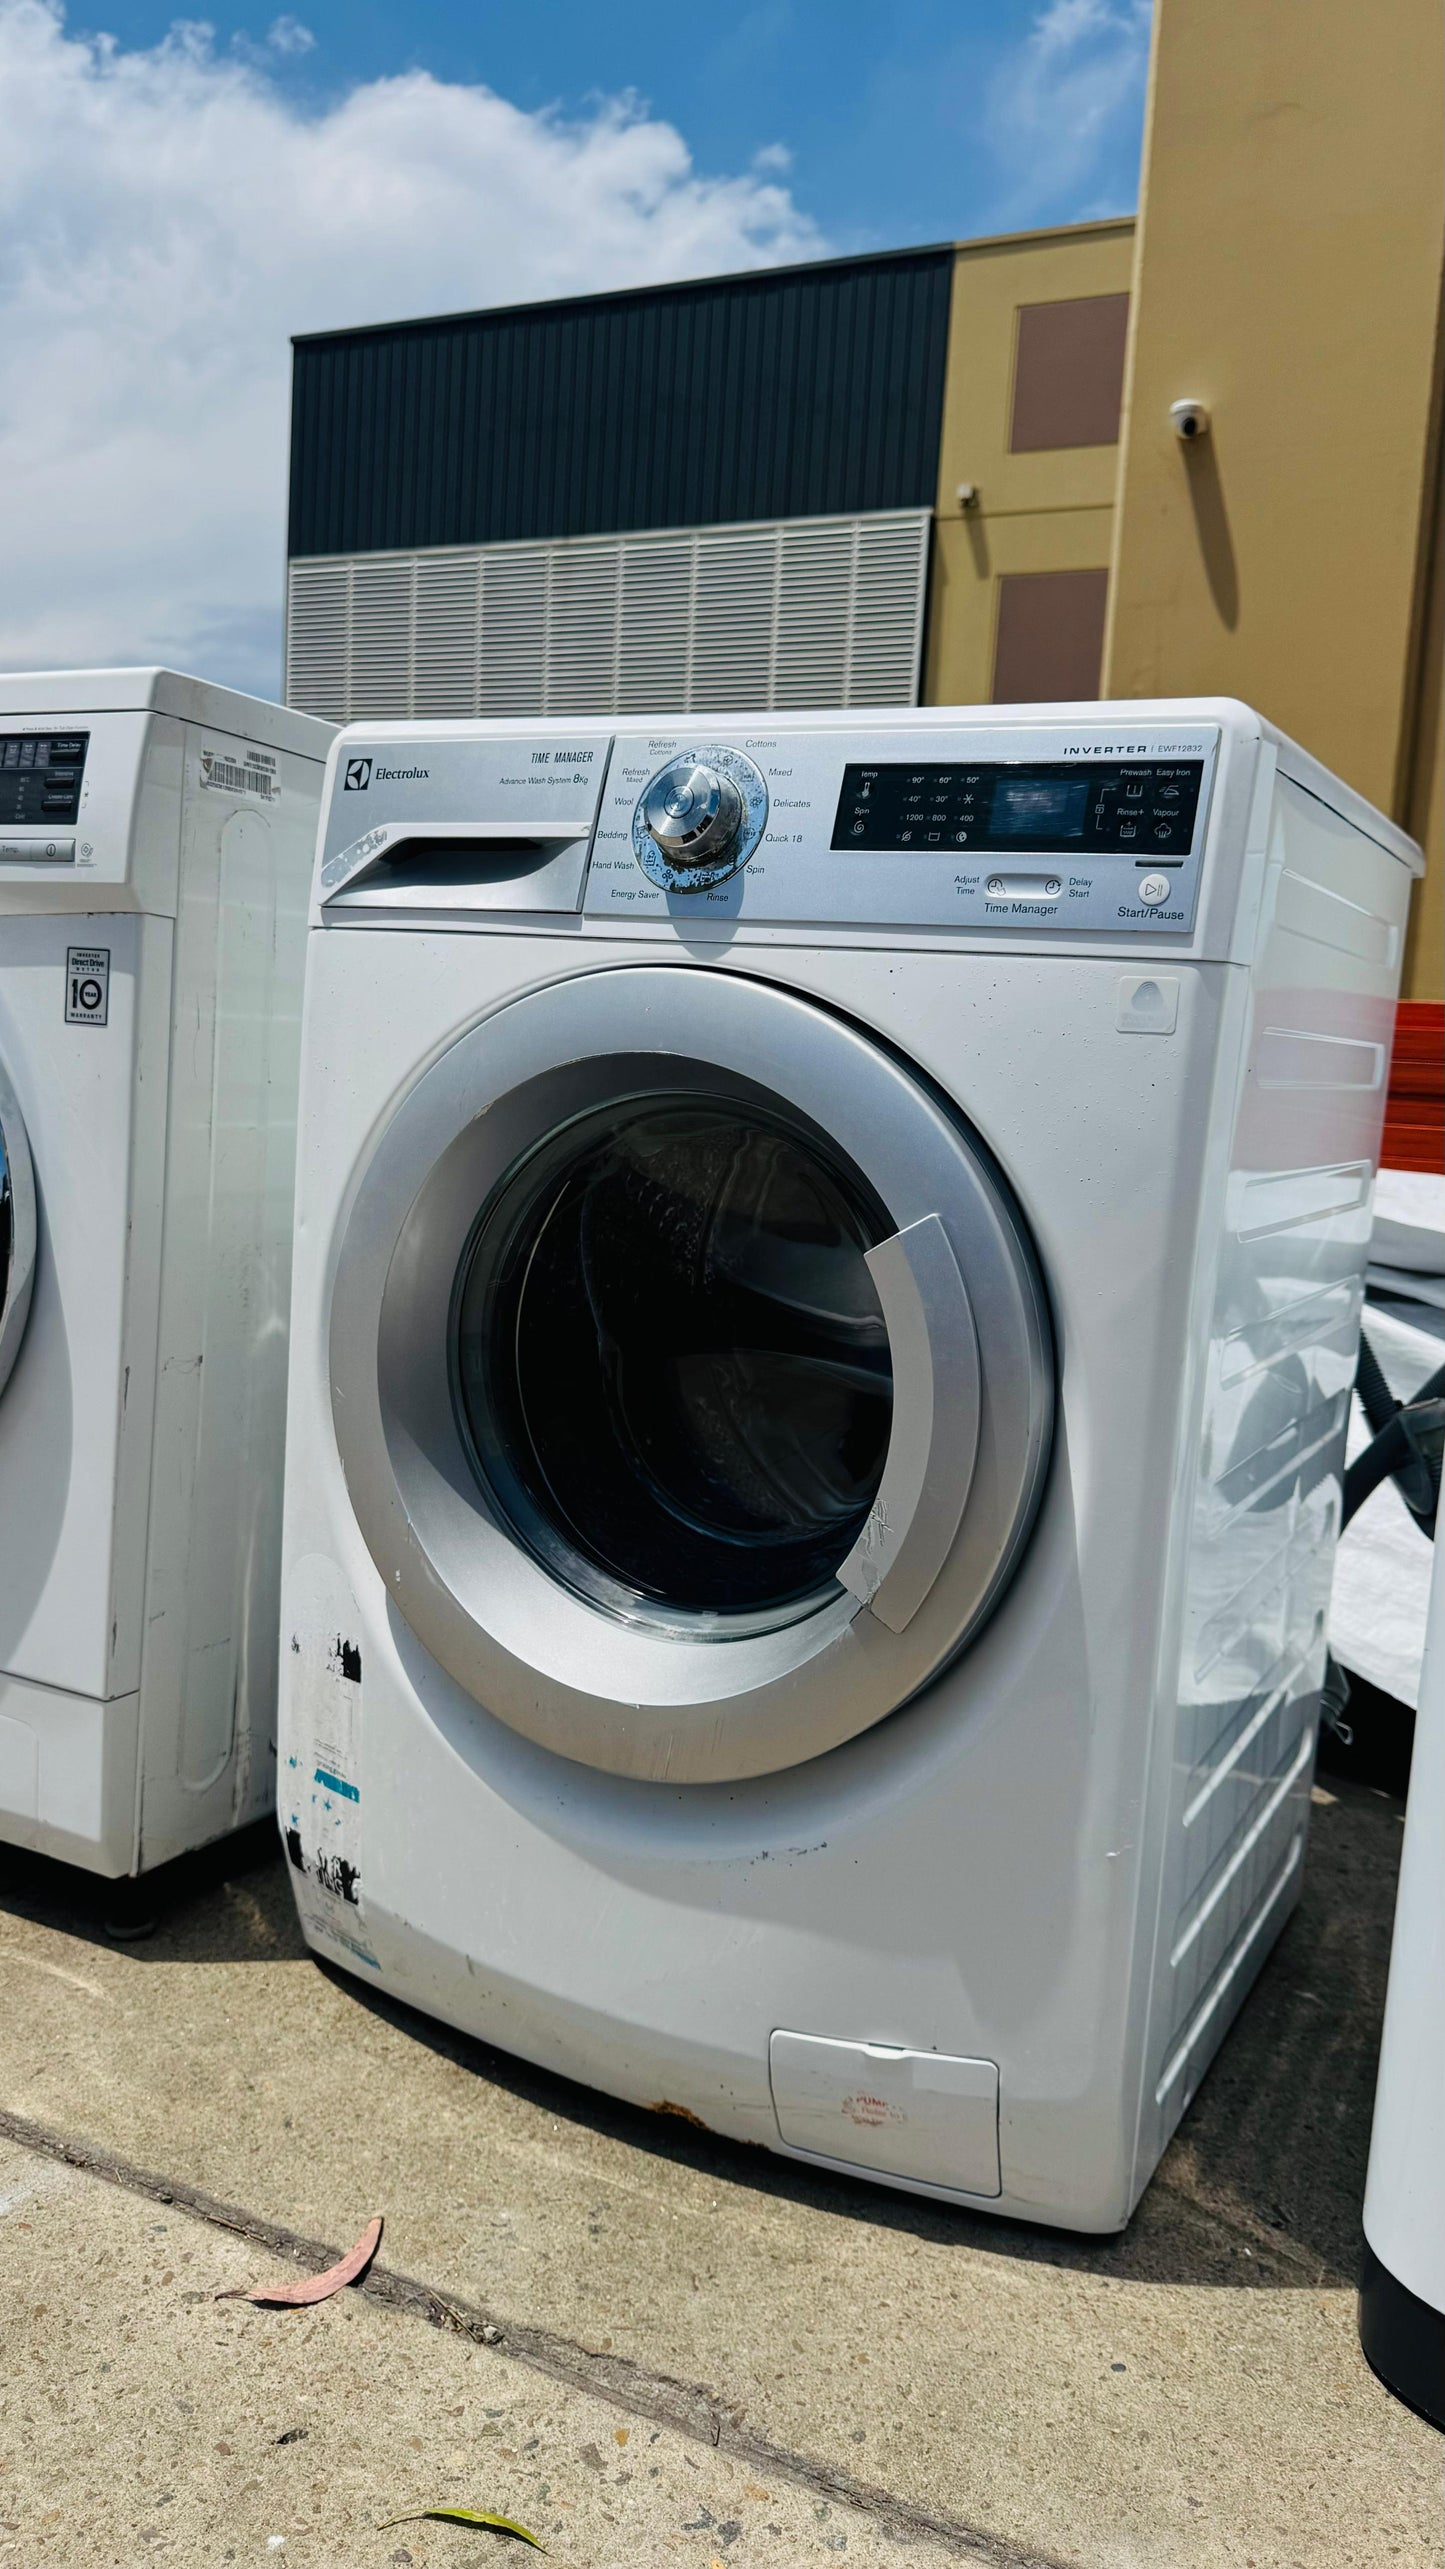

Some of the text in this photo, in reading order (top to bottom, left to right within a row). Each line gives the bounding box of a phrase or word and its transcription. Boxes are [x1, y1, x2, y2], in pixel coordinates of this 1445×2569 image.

[648, 740, 677, 748] Refresh
[745, 739, 777, 748] Cottons
[1063, 745, 1203, 755] INVERTER EWF12832
[531, 751, 593, 764] TIME MANAGER
[375, 768, 430, 780] Electrolux
[622, 768, 650, 776] Refresh
[769, 768, 792, 776] Mixed
[861, 771, 878, 779] Temp
[1156, 769, 1174, 778] Easy
[528, 776, 546, 785] Wash
[547, 776, 571, 786] System
[614, 797, 634, 805] Wool
[773, 799, 811, 808] Delicates
[854, 807, 870, 815] Spin
[1117, 808, 1145, 816] Rinse+
[1153, 808, 1180, 817] Vapour
[905, 813, 974, 822] 1200 800 400
[597, 830, 628, 840] Bedding
[765, 833, 803, 844] Quick 18
[592, 860, 635, 870] Hand Wash
[746, 865, 765, 875] Spin
[954, 875, 980, 885] Adjust
[1069, 877, 1093, 887] Delay
[611, 889, 660, 900] Energy Saver
[956, 886, 975, 895] Time
[1069, 889, 1090, 898] Start
[706, 892, 729, 902] Rinse
[984, 902, 1059, 915] Time Manager
[1117, 906, 1185, 920] Start/Pause
[72, 957, 104, 967] Direct Drive
[72, 978, 102, 1010] 10
